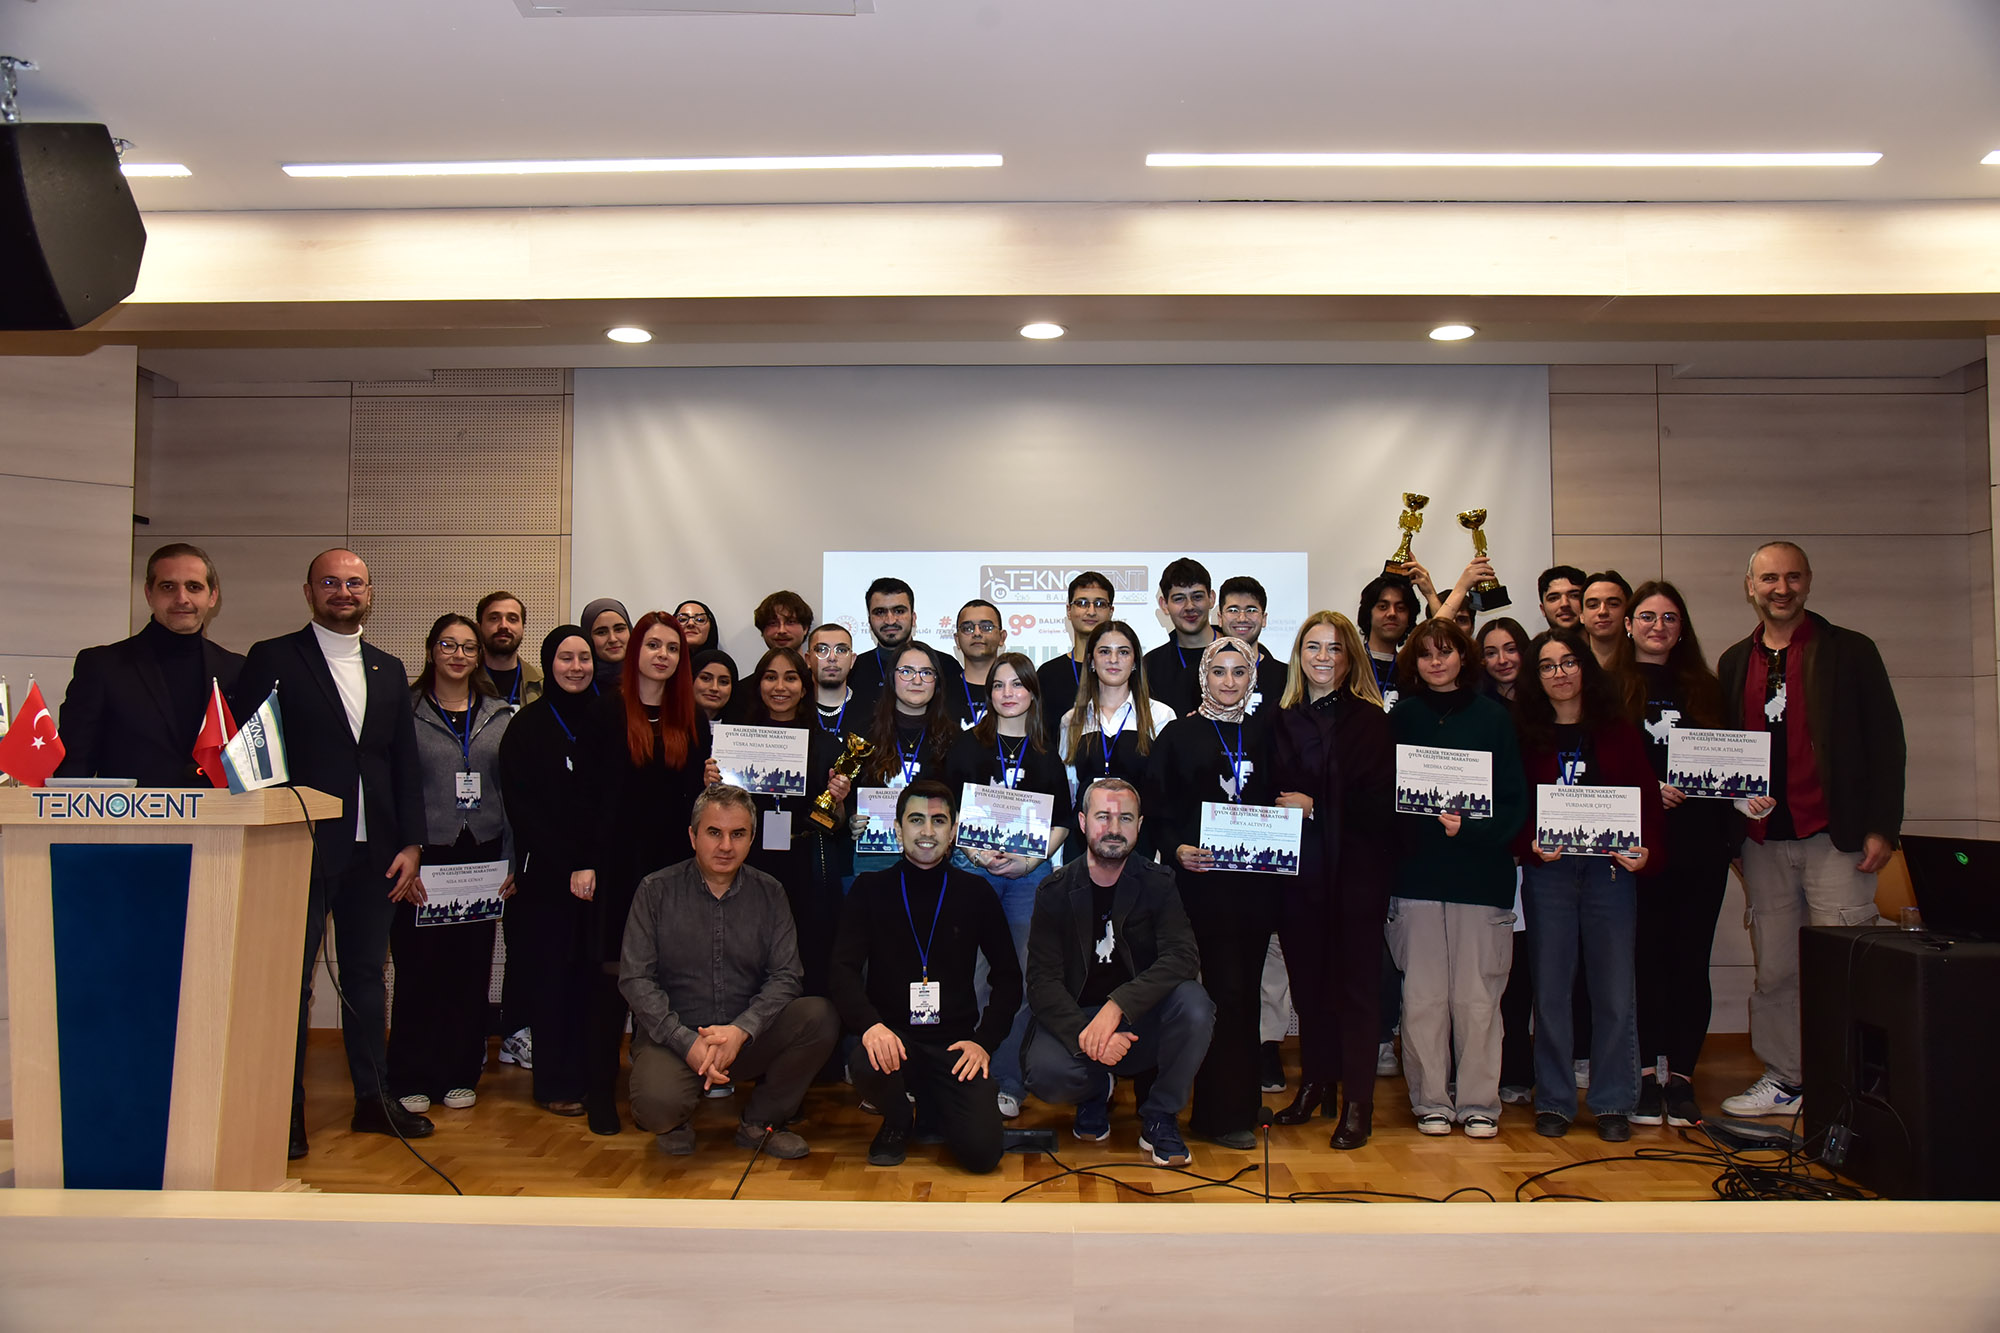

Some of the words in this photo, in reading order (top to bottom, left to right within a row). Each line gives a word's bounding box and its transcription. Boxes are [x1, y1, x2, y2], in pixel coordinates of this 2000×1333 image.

[1004, 570, 1145, 590] TEKNONT
[1009, 615, 1036, 636] go
[32, 793, 203, 818] TEKNOKENT
